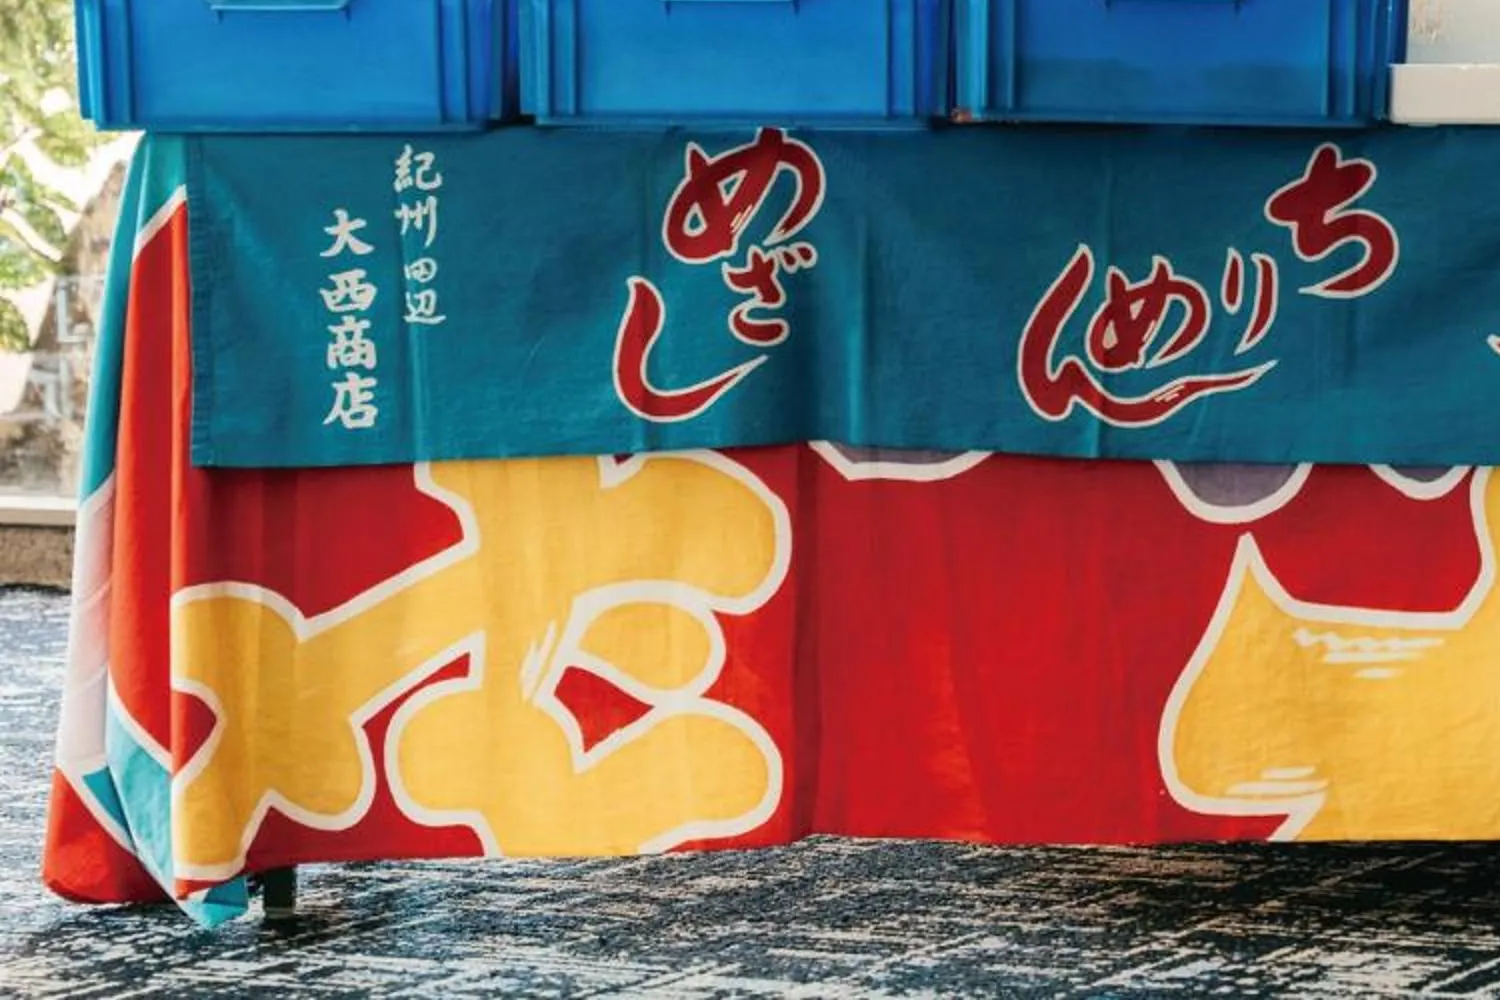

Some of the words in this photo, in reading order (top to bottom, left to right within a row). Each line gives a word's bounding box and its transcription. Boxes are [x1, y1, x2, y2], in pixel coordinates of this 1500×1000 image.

[318, 208, 380, 431] 大西商店
[393, 143, 446, 325] 紀州田辺
[612, 127, 826, 423] めざし
[1017, 142, 1401, 428] ちりめん
